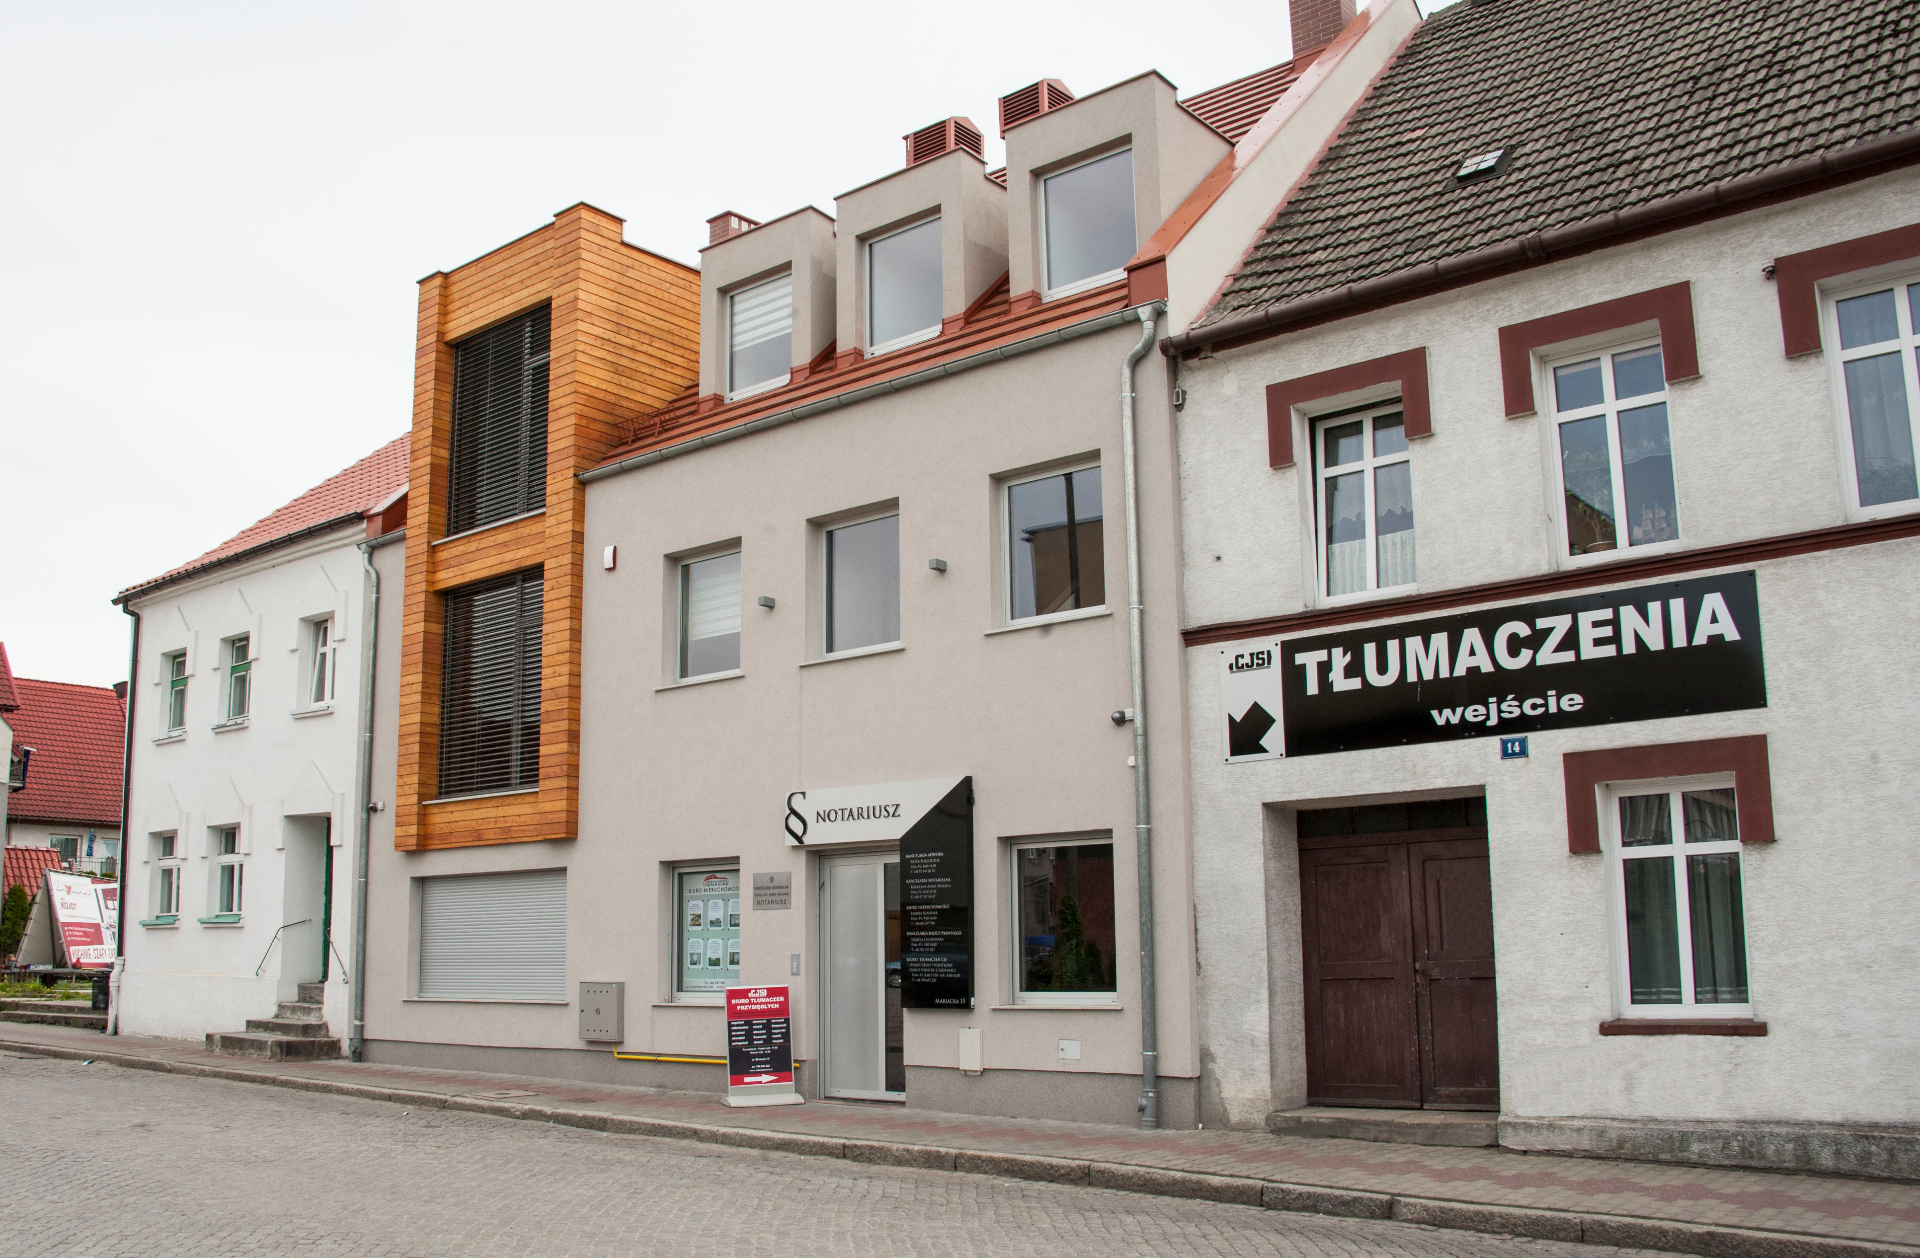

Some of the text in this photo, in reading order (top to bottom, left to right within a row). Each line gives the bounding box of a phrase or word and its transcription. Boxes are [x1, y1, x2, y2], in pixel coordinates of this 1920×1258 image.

[1295, 592, 1741, 696] TŁUMACZENIA
[1430, 689, 1585, 727] wejście
[1507, 742, 1520, 754] 14
[815, 804, 901, 824] NOTARIUSZ
